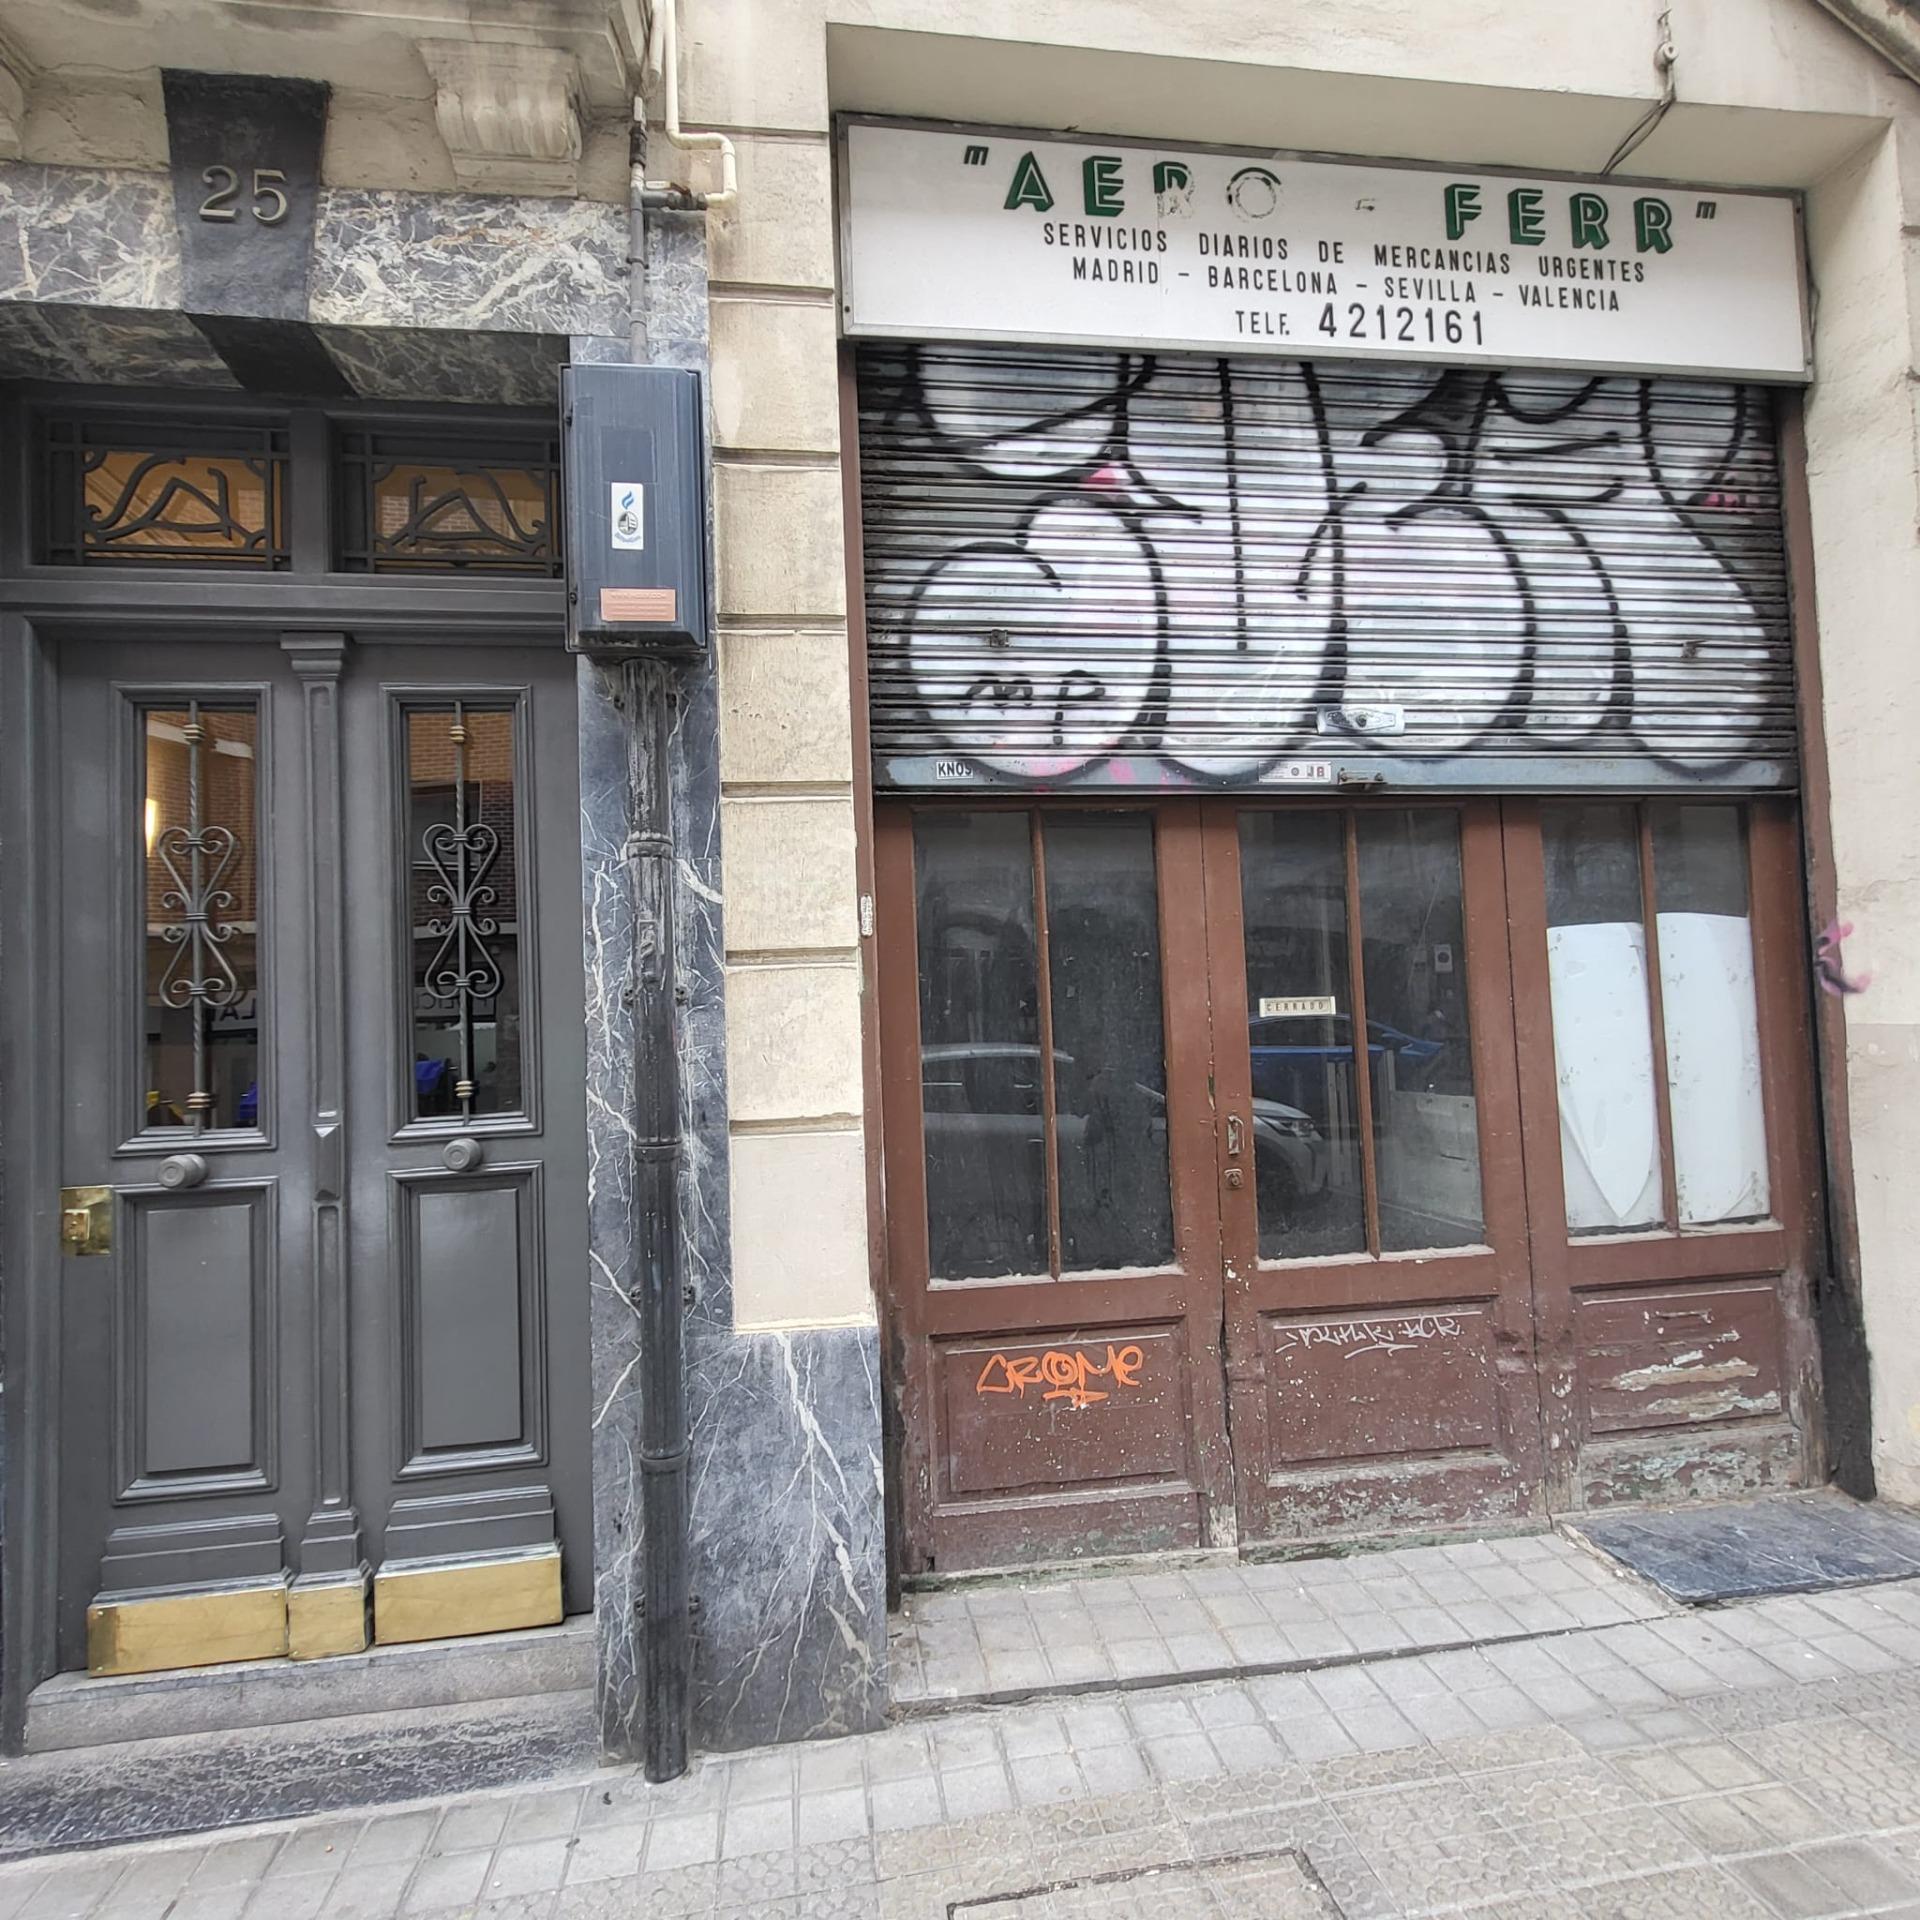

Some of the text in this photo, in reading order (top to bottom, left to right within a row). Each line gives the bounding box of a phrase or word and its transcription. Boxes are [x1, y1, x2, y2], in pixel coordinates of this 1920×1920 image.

[199, 164, 290, 226] 25
[1043, 222, 1646, 283] SERVICIOS DIARIOS DE MERCANCIAS URGENTES
[1072, 256, 1160, 285] MADRID
[1207, 265, 1338, 296] BARCELONA
[1384, 276, 1477, 304] SEVILLA
[1519, 284, 1620, 313] VALENCIA
[1235, 302, 1483, 346] TELF. 4212161
[1265, 1001, 1324, 1012] CERRADO
